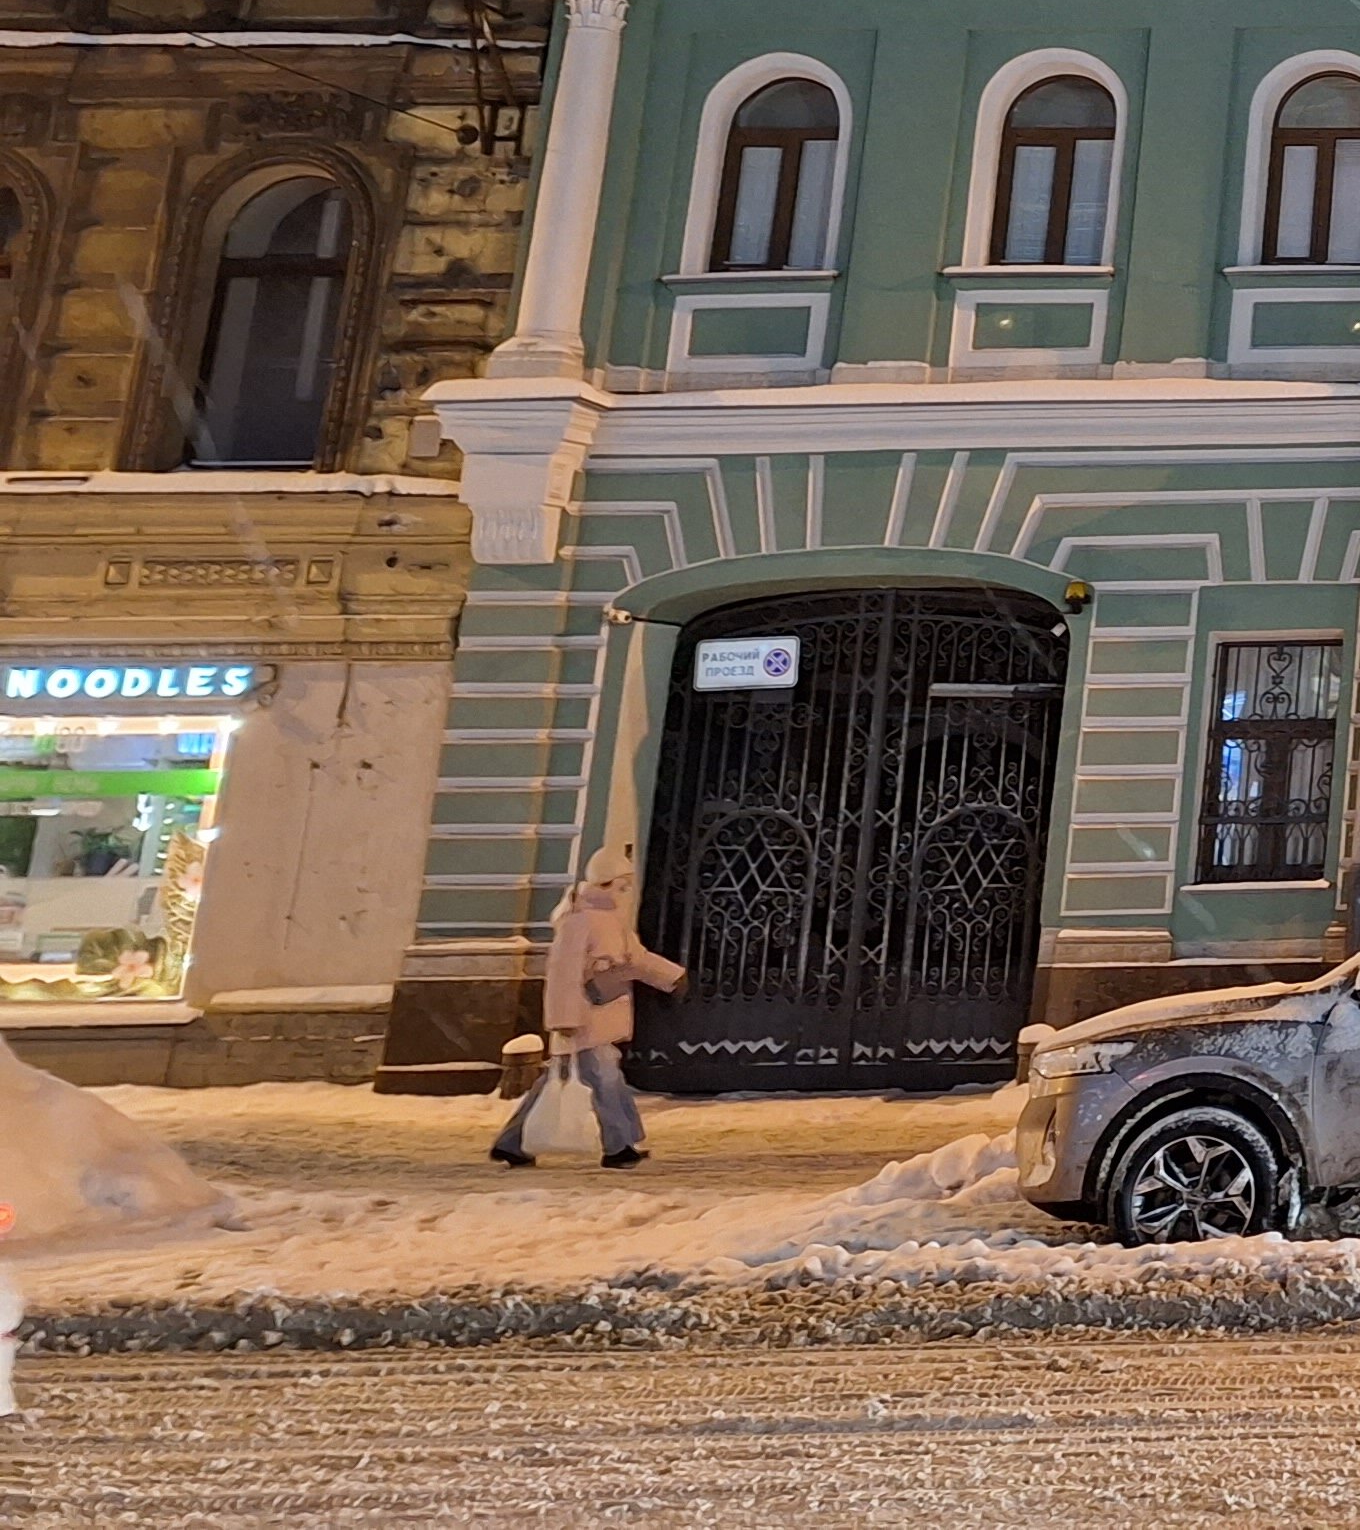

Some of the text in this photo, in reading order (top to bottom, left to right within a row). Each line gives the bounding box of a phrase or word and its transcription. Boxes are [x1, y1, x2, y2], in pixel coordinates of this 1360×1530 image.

[702, 649, 760, 663] РАБОЧИЙ
[705, 665, 755, 677] ПРОЕЗД
[6, 666, 252, 698] NOODLES
